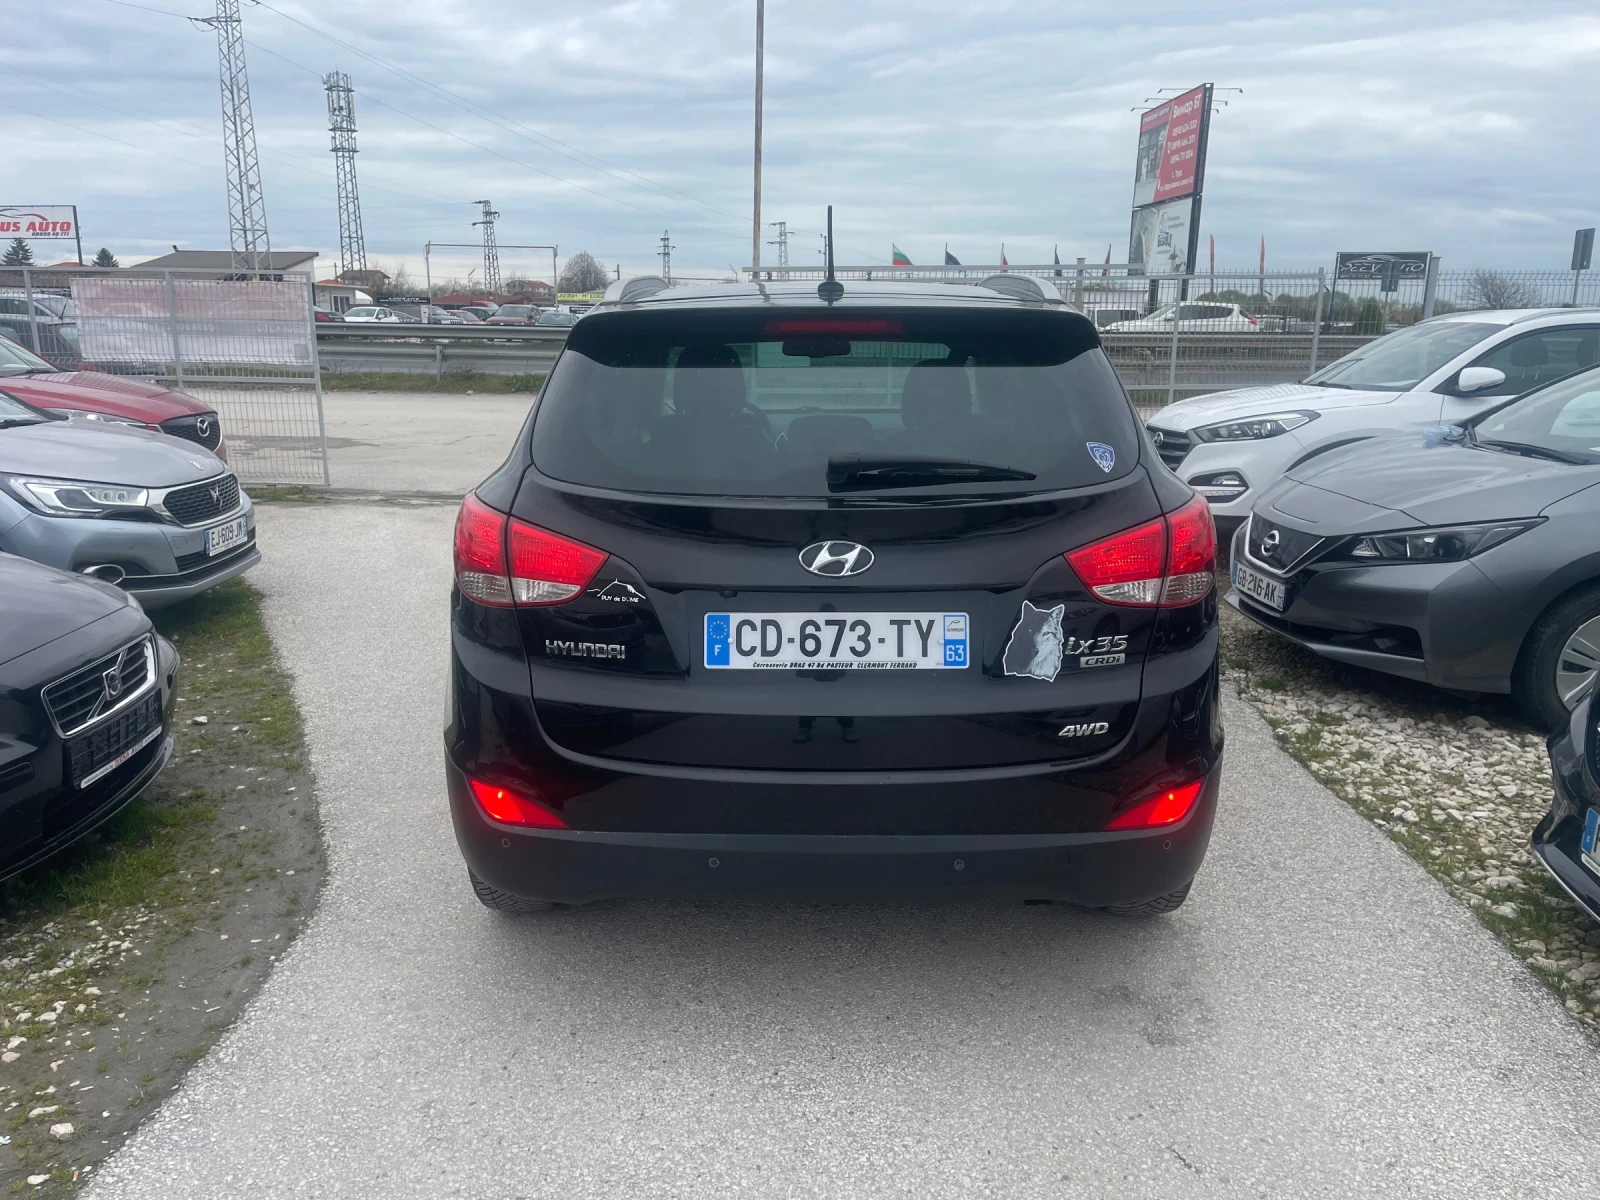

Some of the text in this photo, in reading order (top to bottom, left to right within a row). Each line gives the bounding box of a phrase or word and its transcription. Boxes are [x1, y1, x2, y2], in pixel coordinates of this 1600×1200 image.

[26, 221, 72, 232] AUTO
[211, 521, 243, 548] EJ-609-JM
[1238, 567, 1277, 603] GB-216-AK
[735, 619, 936, 658] CD-673-TY
[1065, 634, 1129, 655] ix35
[545, 639, 626, 660] HYUNDAI
[714, 644, 722, 656] F
[946, 644, 965, 662] 63
[1084, 655, 1122, 666] CRDi
[1058, 722, 1110, 738] 4WD
